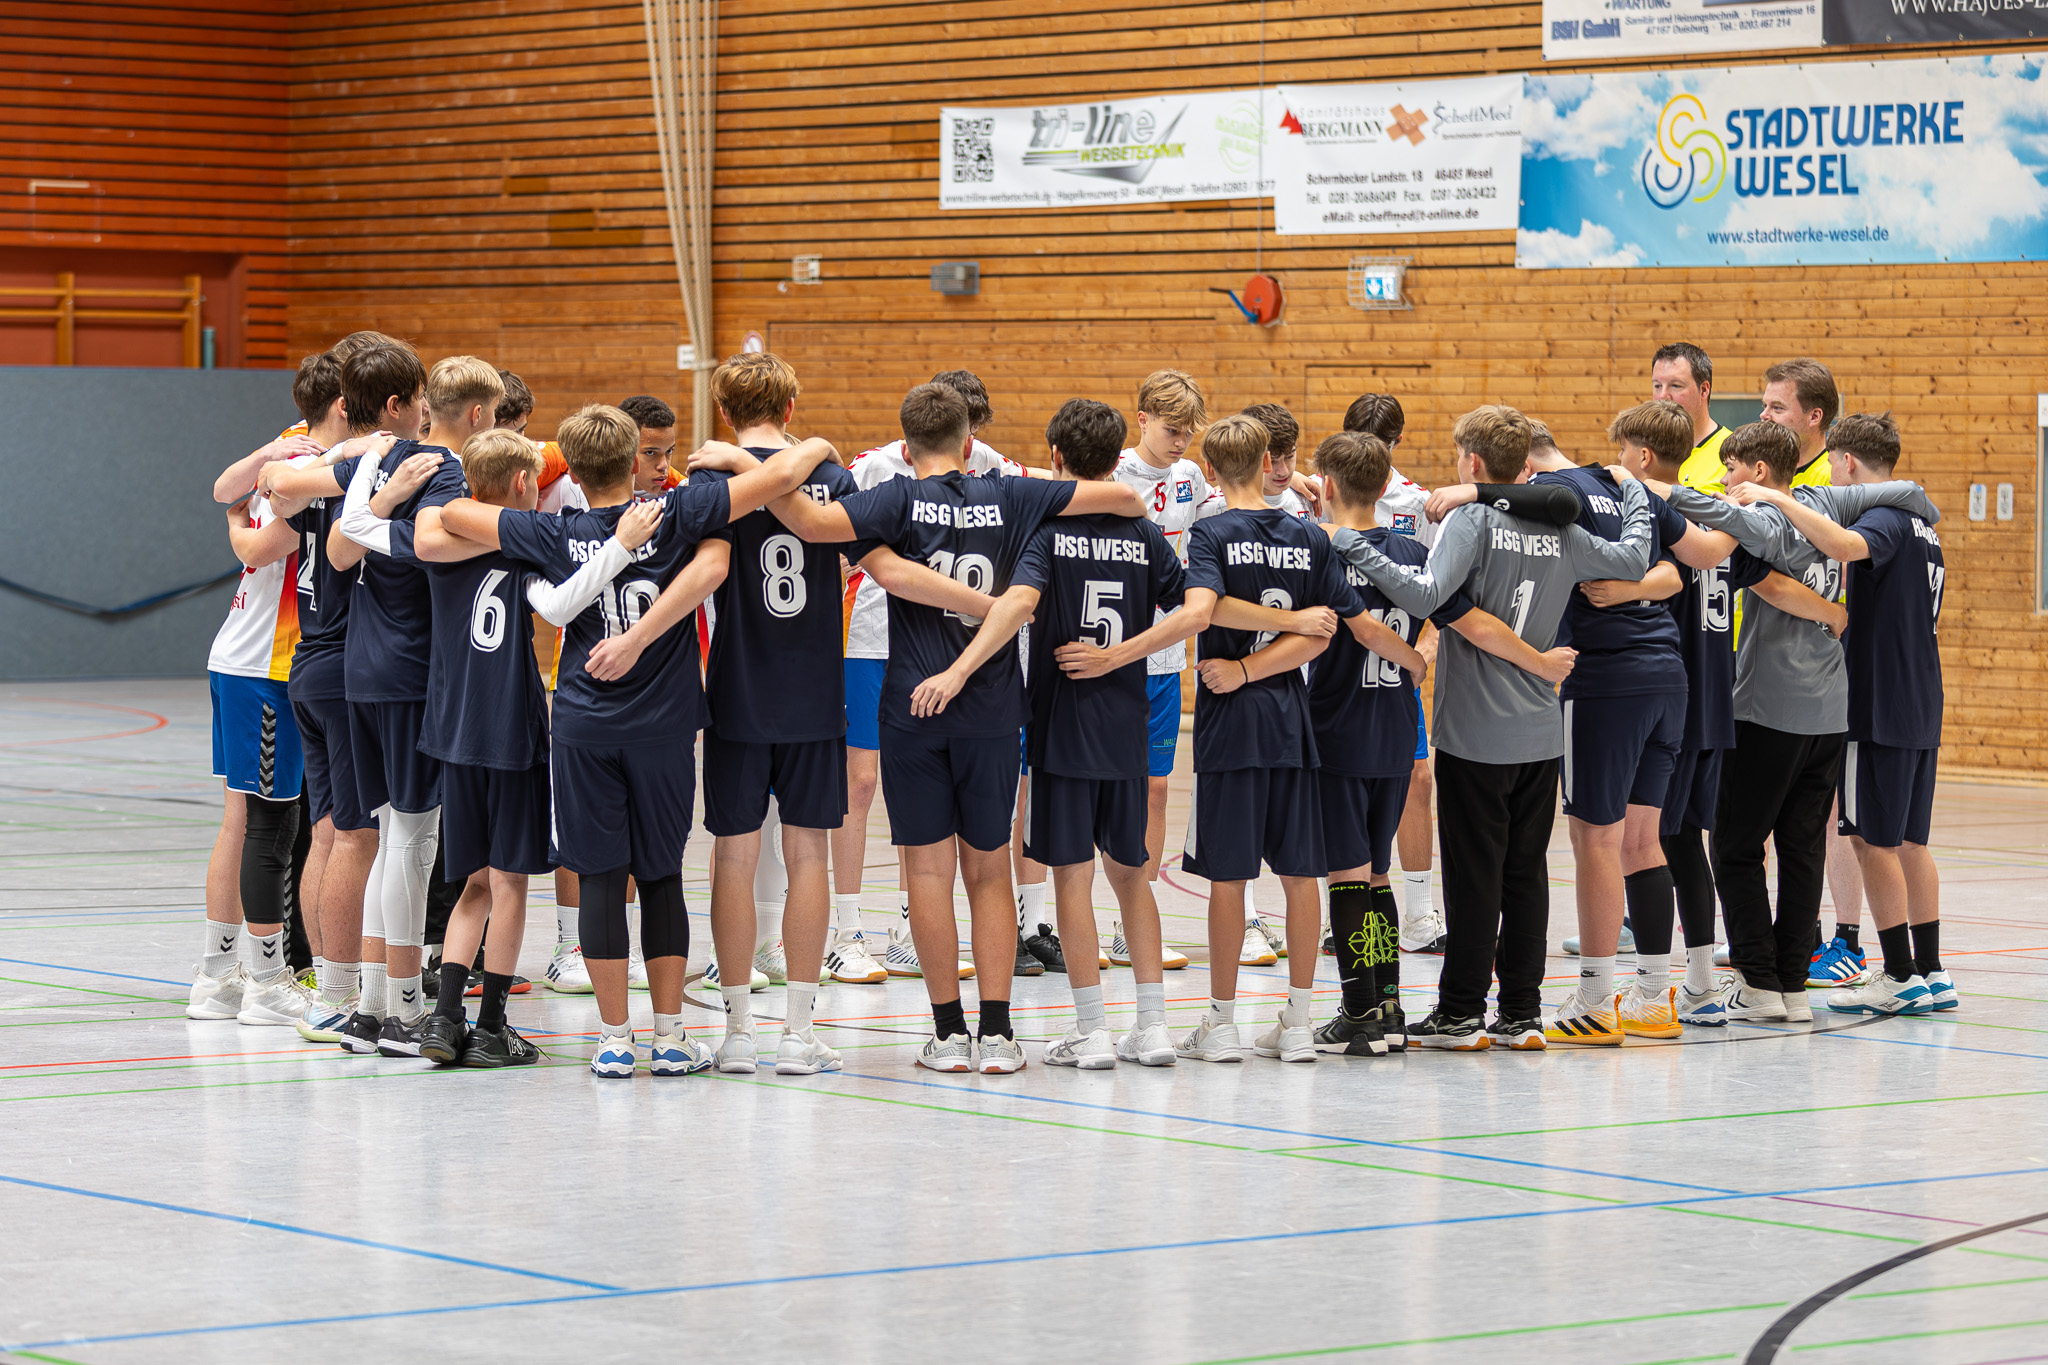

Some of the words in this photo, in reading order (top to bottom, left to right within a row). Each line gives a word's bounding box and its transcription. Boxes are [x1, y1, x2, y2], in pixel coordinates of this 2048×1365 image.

[1029, 105, 1156, 147] tri-line
[1300, 121, 1383, 138] BERGMANN
[1726, 101, 1964, 151] STADTWERKE
[1080, 143, 1187, 162] WERBETECHNIK
[1306, 172, 1369, 185] Schermbecker
[1465, 166, 1494, 180] Wesel
[1735, 153, 1859, 198] WESEL
[1707, 227, 1889, 246] www.stadtwerke-wesel.de
[1154, 482, 1167, 512] 5
[912, 500, 951, 526] HSG
[1054, 533, 1090, 560] HSG
[1091, 537, 1149, 566] WESEL
[1227, 541, 1263, 566] HSG
[1264, 546, 1311, 571] WESE
[1491, 528, 1521, 553] HSG
[1521, 533, 1561, 558] WESE
[760, 534, 807, 618] 8
[1346, 565, 1374, 587] HS
[471, 569, 508, 652] 6
[1079, 580, 1124, 649] 5
